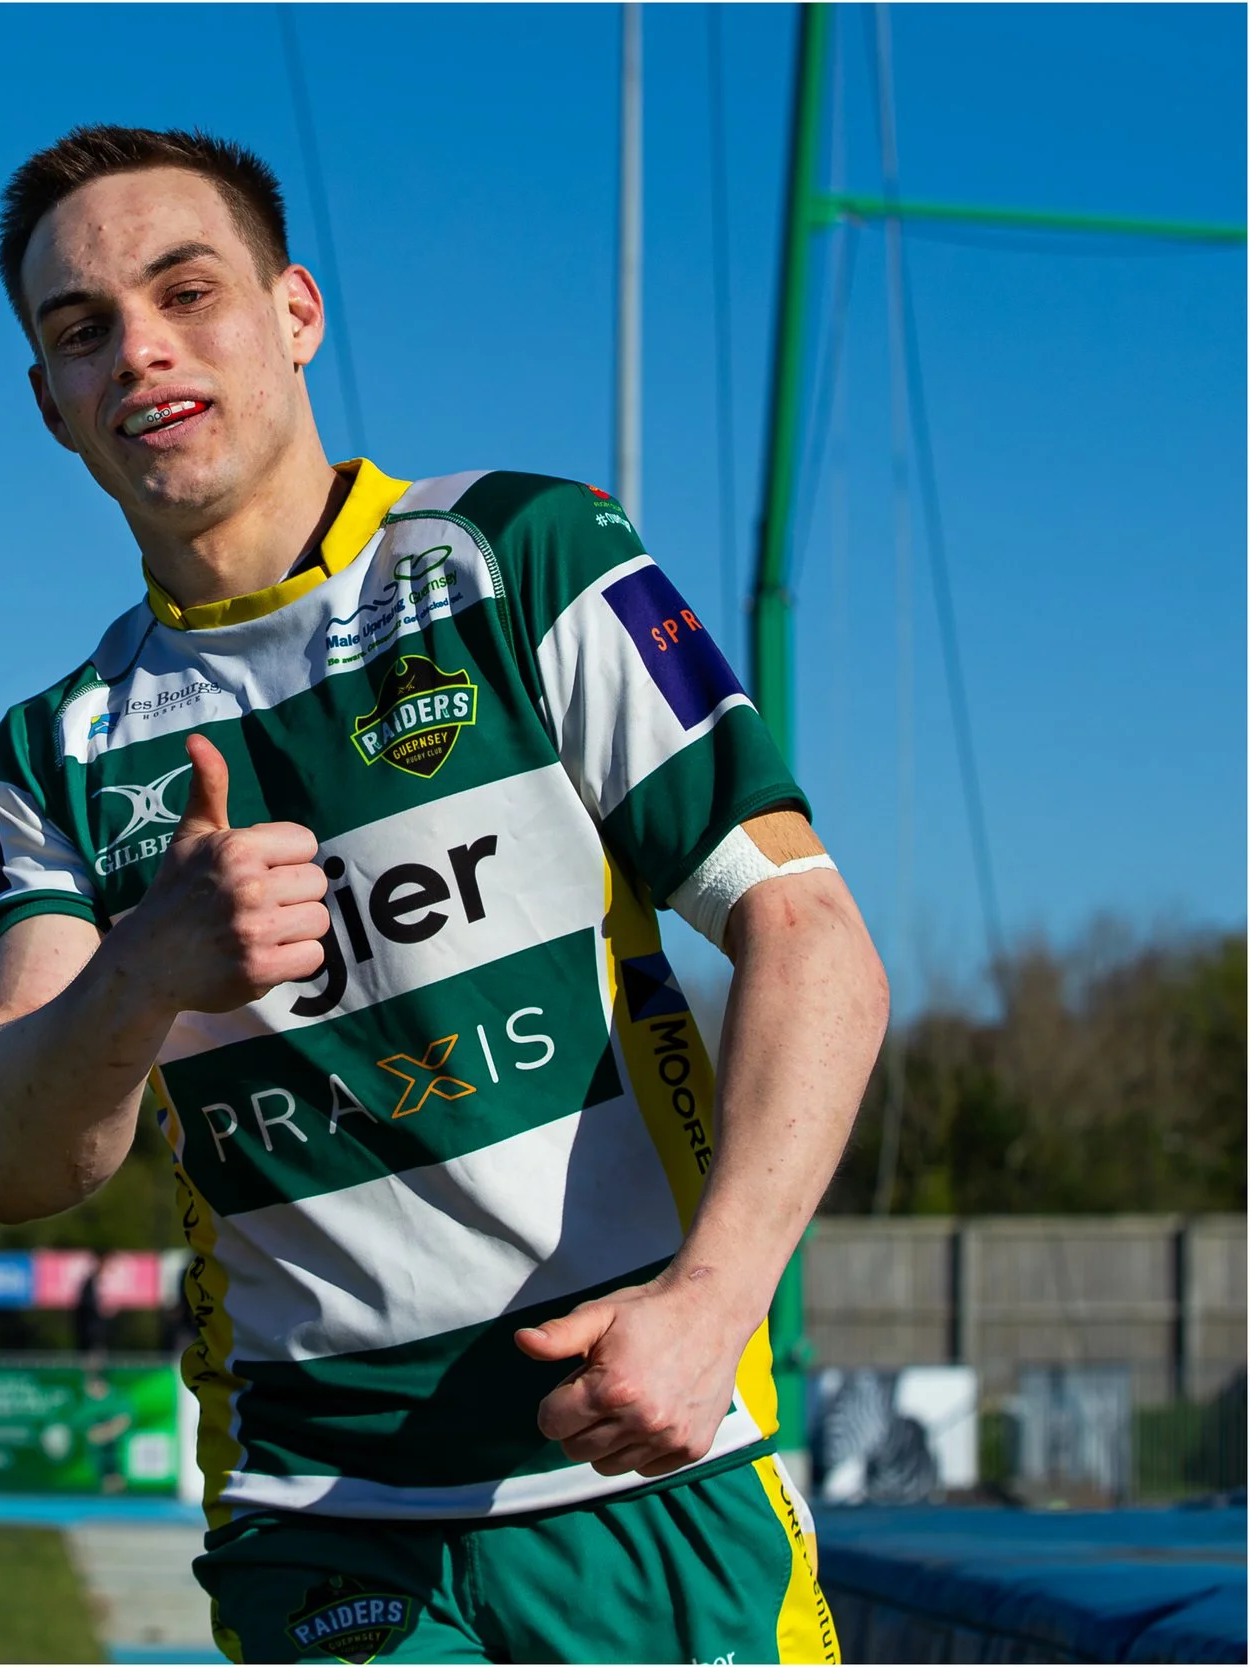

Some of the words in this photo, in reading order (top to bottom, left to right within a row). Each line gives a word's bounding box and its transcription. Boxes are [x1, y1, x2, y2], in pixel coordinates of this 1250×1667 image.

[326, 633, 361, 650] Male
[408, 570, 458, 605] Guernsey
[651, 608, 703, 652] SPR
[142, 695, 202, 720] HOSPICE
[156, 680, 222, 707] Bourgs
[361, 691, 470, 756] RAIDERS
[392, 731, 449, 760] GUERNSEY
[405, 753, 426, 765] RUGBY
[427, 746, 443, 758] CLUB
[201, 1006, 556, 1163] PRAXIS
[650, 1018, 713, 1176] MOORE
[294, 1599, 403, 1645] RAIDERS
